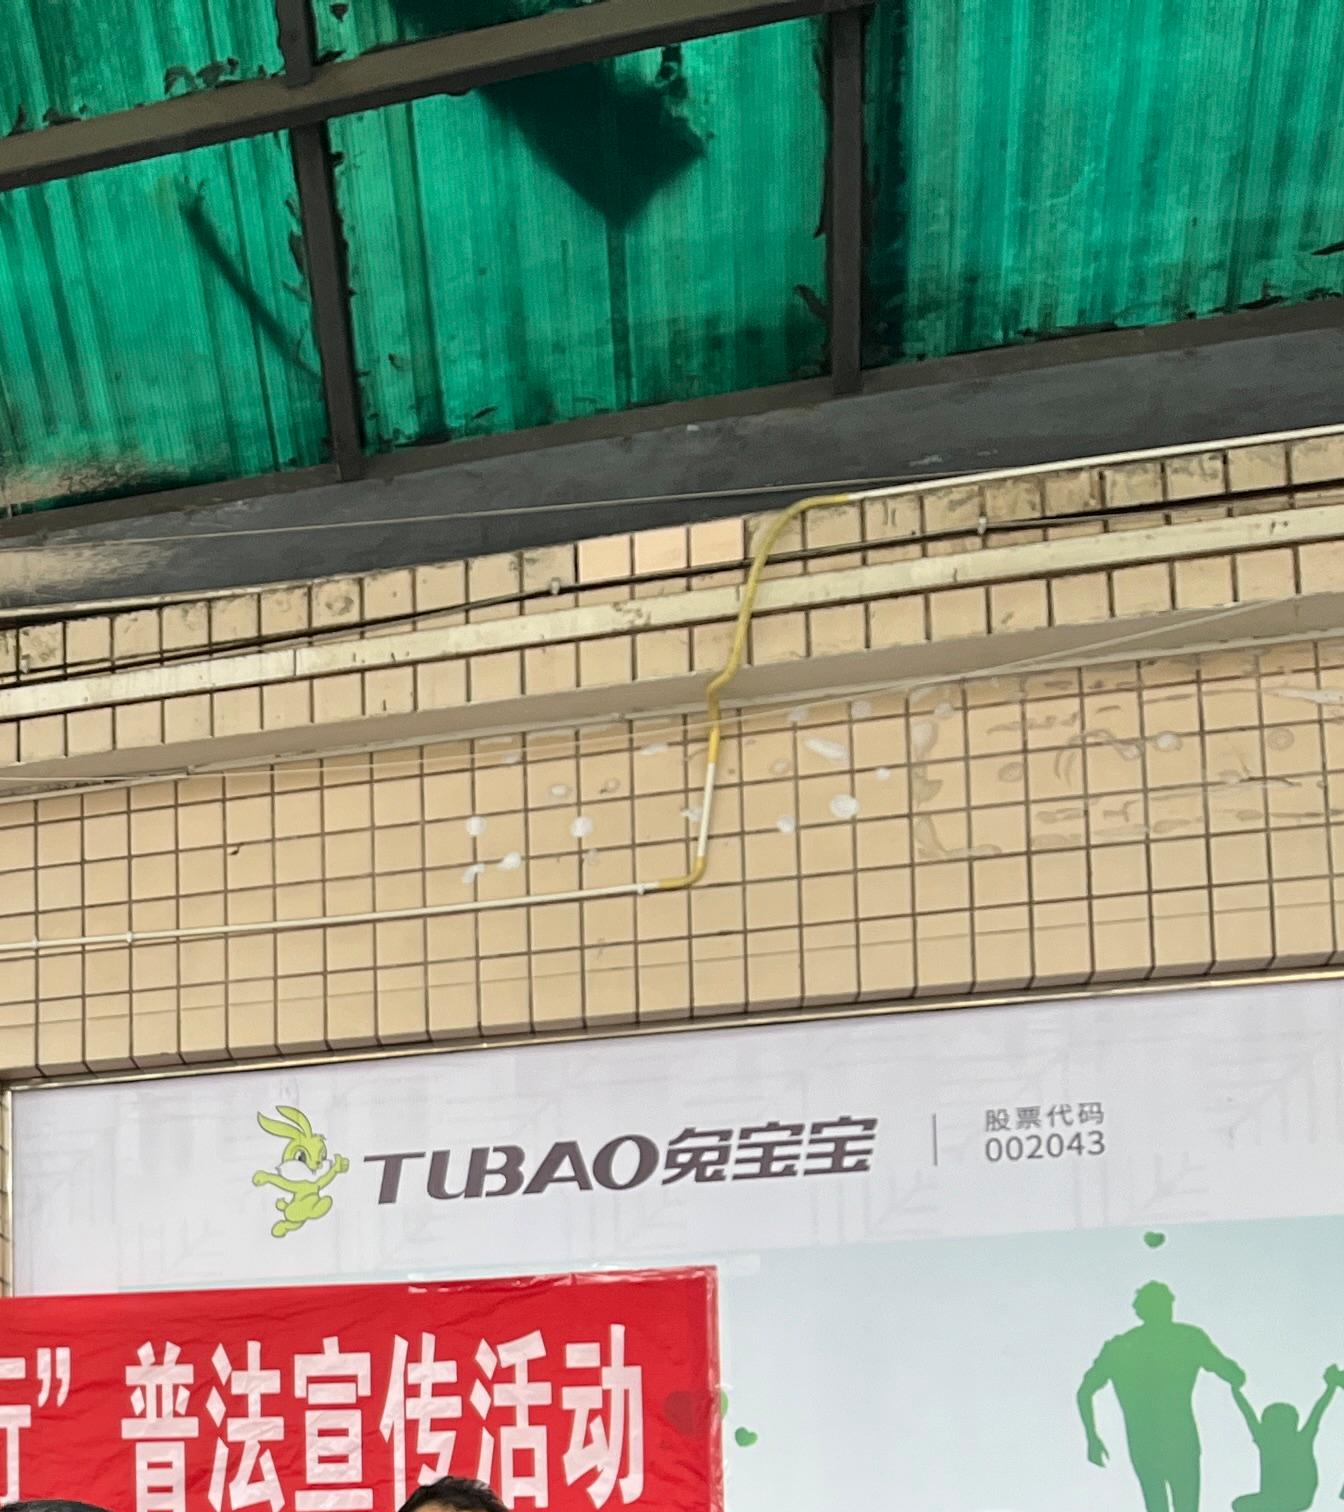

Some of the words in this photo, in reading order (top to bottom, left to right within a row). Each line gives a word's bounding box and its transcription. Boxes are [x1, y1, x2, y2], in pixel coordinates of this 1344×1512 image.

[984, 1101, 1105, 1132] 股票代码
[984, 1130, 1106, 1162] 002043
